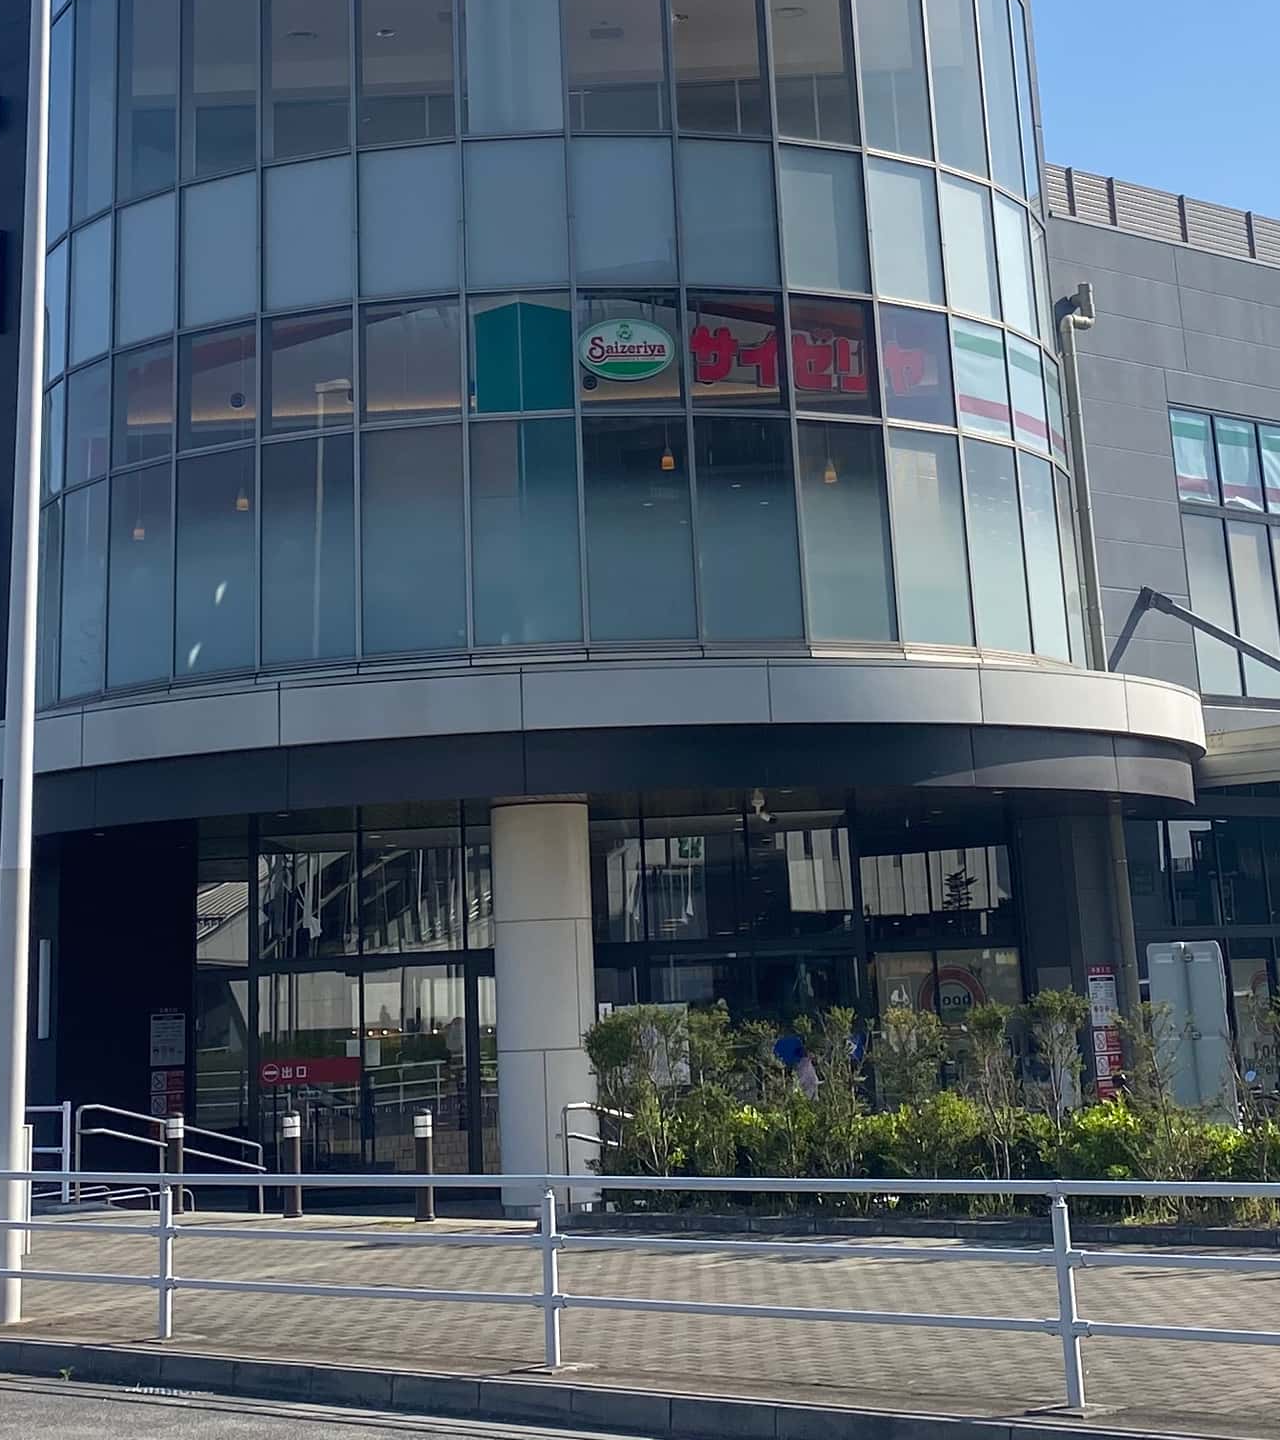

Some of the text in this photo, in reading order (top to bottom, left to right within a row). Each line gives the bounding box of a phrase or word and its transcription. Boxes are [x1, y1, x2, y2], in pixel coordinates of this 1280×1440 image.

[587, 335, 666, 361] Saizeriya
[689, 325, 927, 395] サイゼリヤ
[281, 1066, 307, 1079] 出口
